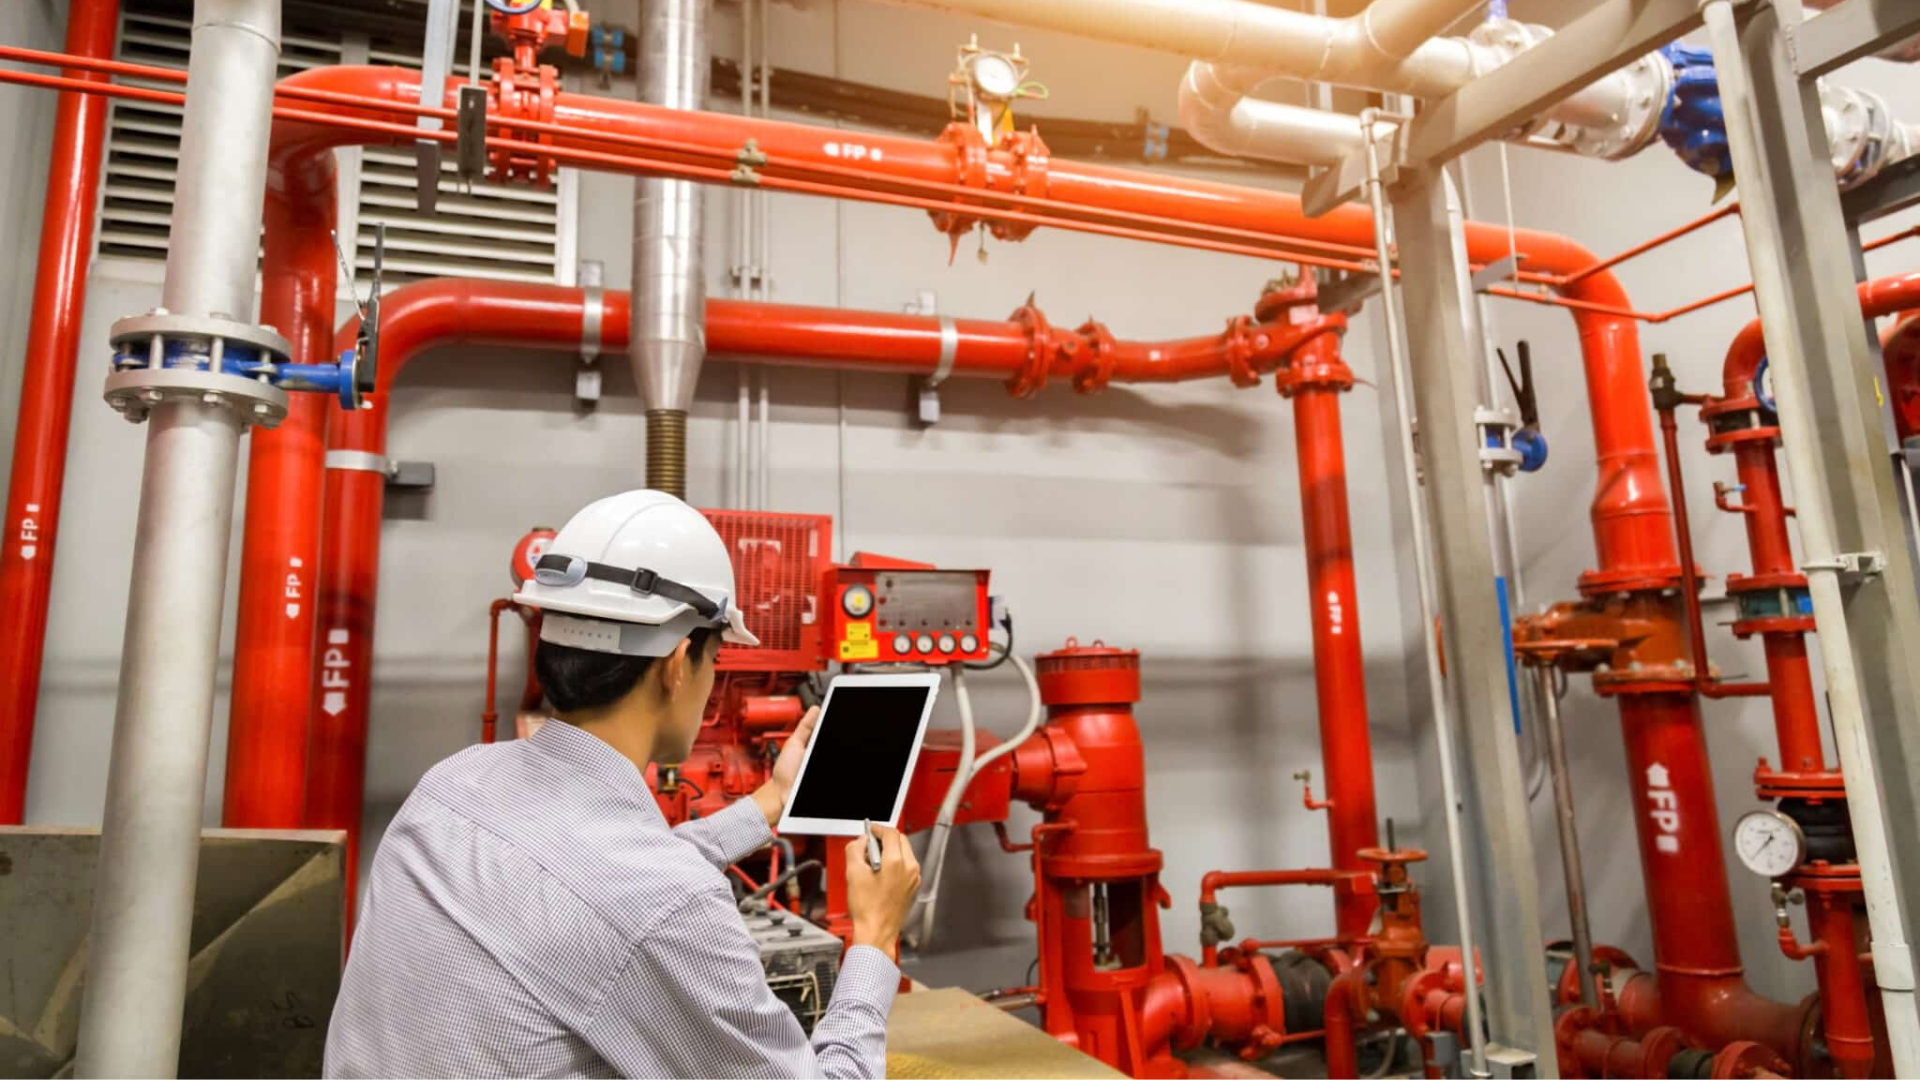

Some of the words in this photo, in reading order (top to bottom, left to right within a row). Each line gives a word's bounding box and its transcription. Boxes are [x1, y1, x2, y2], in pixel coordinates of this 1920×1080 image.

[21, 518, 39, 541] FP
[285, 573, 302, 598] FP
[322, 648, 351, 688] FP
[1647, 790, 1679, 833] FP
